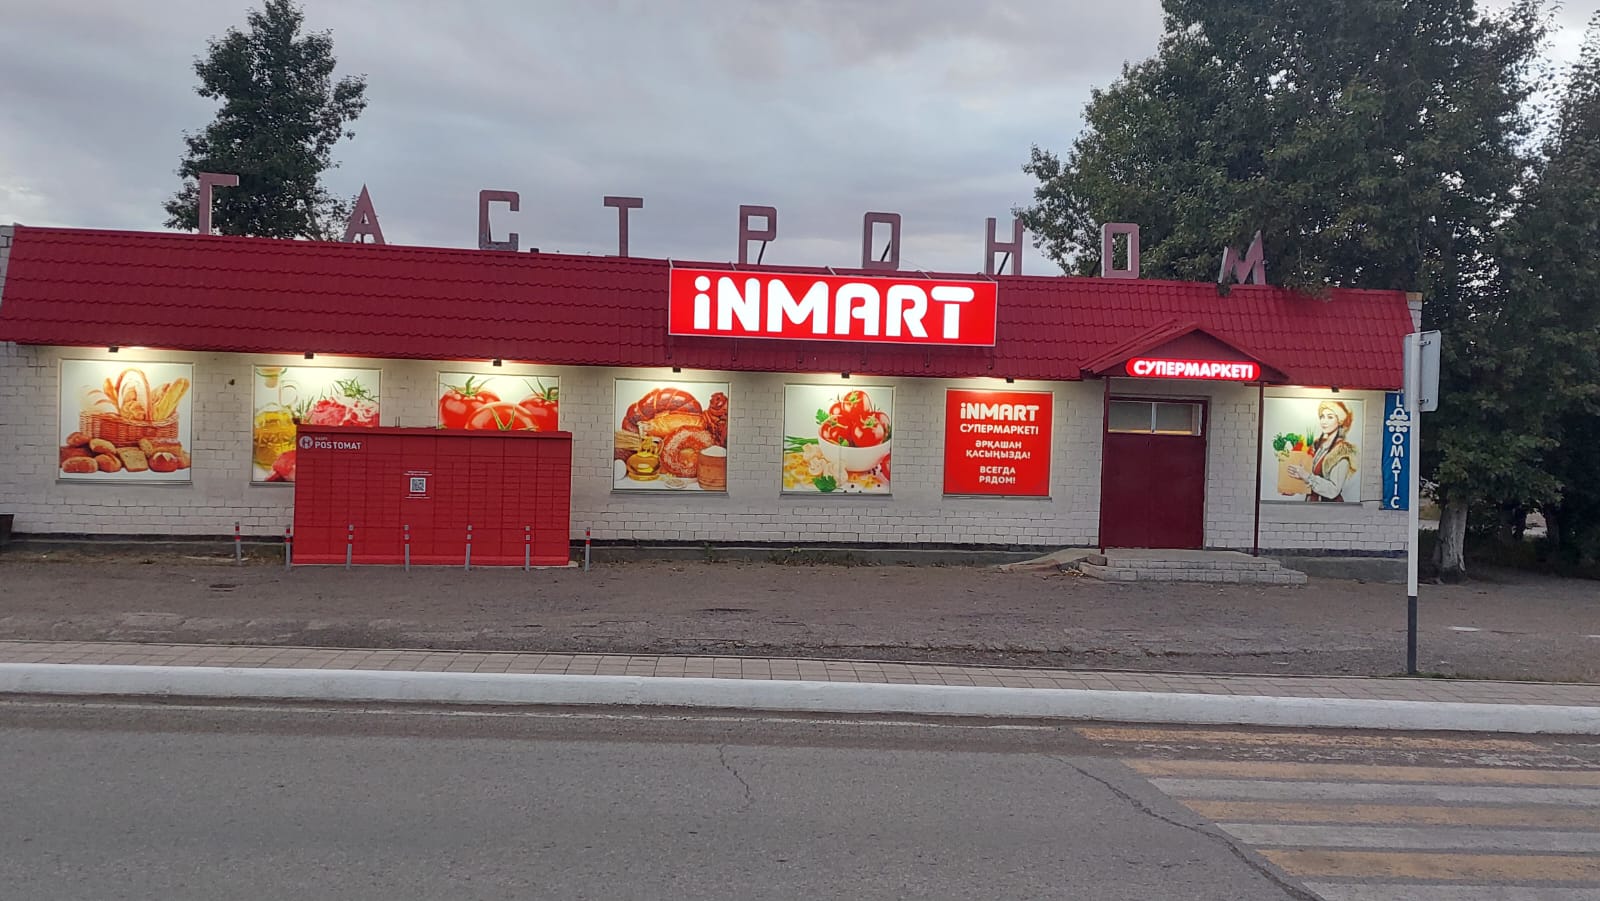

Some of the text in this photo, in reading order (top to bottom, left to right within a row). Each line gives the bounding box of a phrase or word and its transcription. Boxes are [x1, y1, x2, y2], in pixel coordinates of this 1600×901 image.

[199, 172, 1266, 286] ГАСТРОНОМ
[693, 275, 975, 339] iNMART
[1133, 360, 1254, 379] СУПЕРМАРКЕТІ
[960, 402, 1040, 421] iNMART
[960, 423, 1039, 435] СУПЕРМАРКЕТІ
[314, 441, 362, 450] POSTOMAT
[975, 440, 1022, 449] ӘРҚАШАН
[966, 450, 1031, 460] ҚАСЫҢЫЗДА!
[979, 466, 1016, 475] ВСЕГДА
[979, 475, 1016, 485] РЯДОМ!
